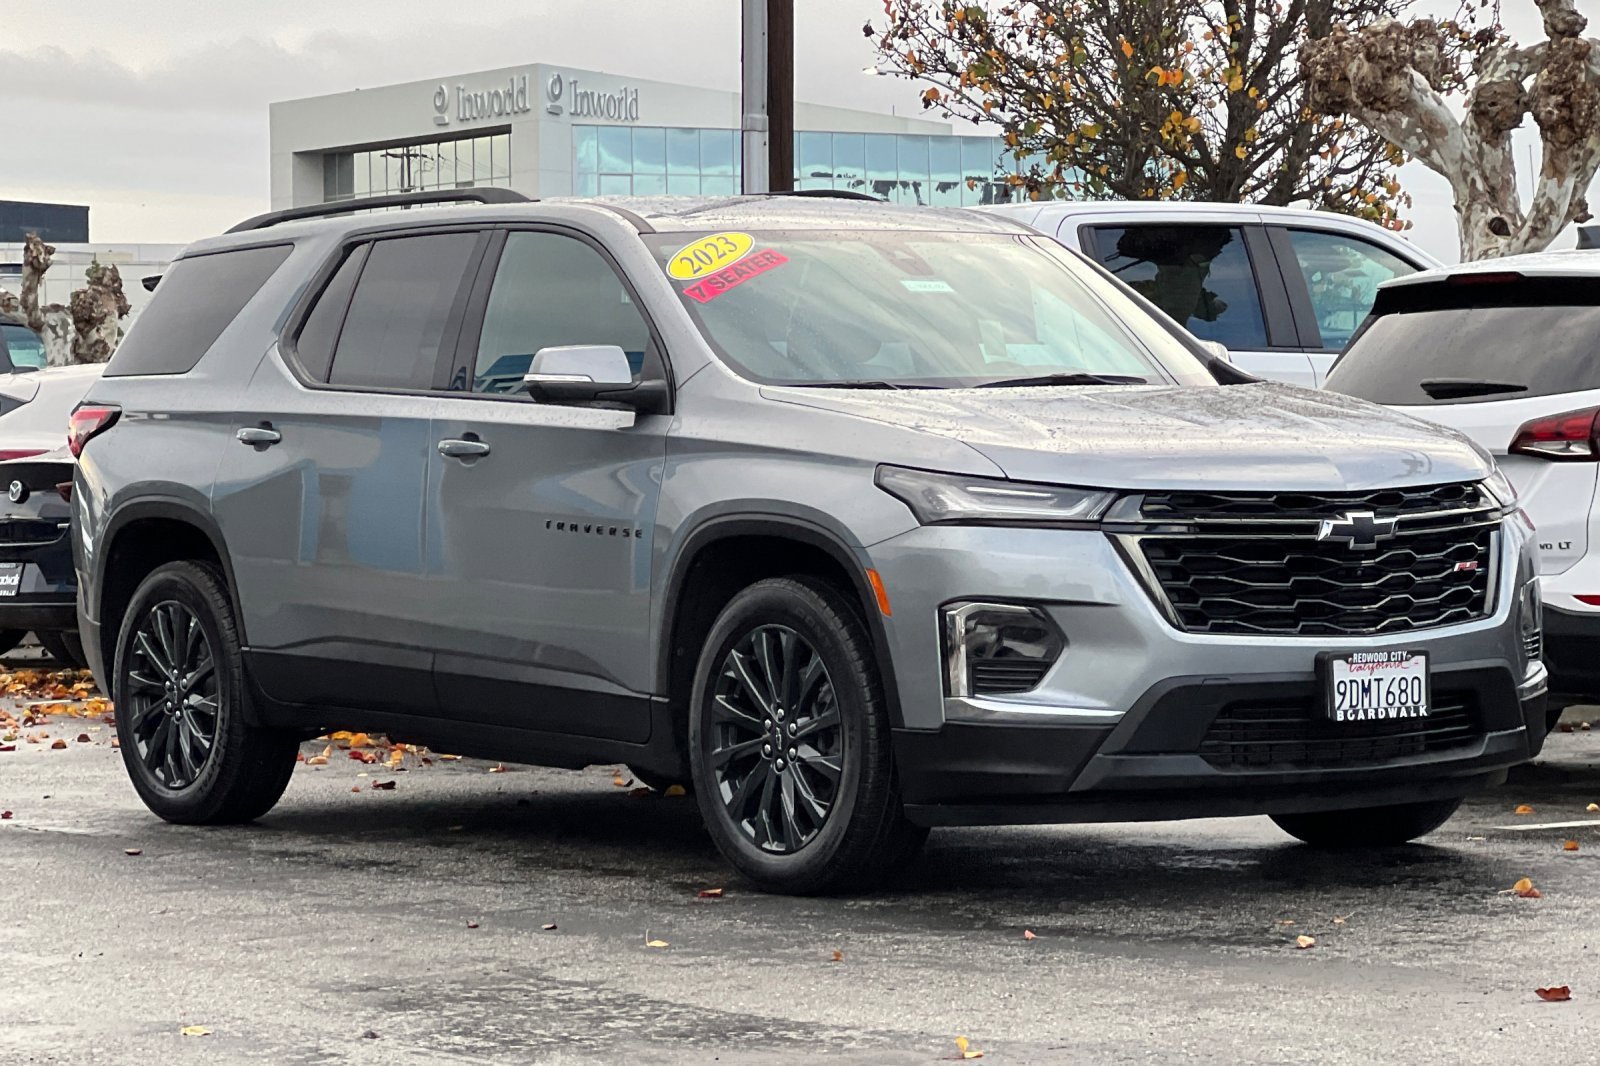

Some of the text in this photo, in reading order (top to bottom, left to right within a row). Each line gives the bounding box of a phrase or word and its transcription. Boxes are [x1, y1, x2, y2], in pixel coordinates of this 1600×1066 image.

[456, 74, 531, 121] Inworld
[569, 79, 639, 121] Inworld
[679, 236, 738, 275] 2023
[689, 252, 780, 299] 7 SEATER
[545, 520, 642, 539] TRAVERSE
[1558, 541, 1572, 550] LT
[1353, 650, 1408, 663] REDWOOD CITY
[1336, 676, 1422, 710] 9DMT680
[1336, 705, 1428, 721] BOARDWALK
